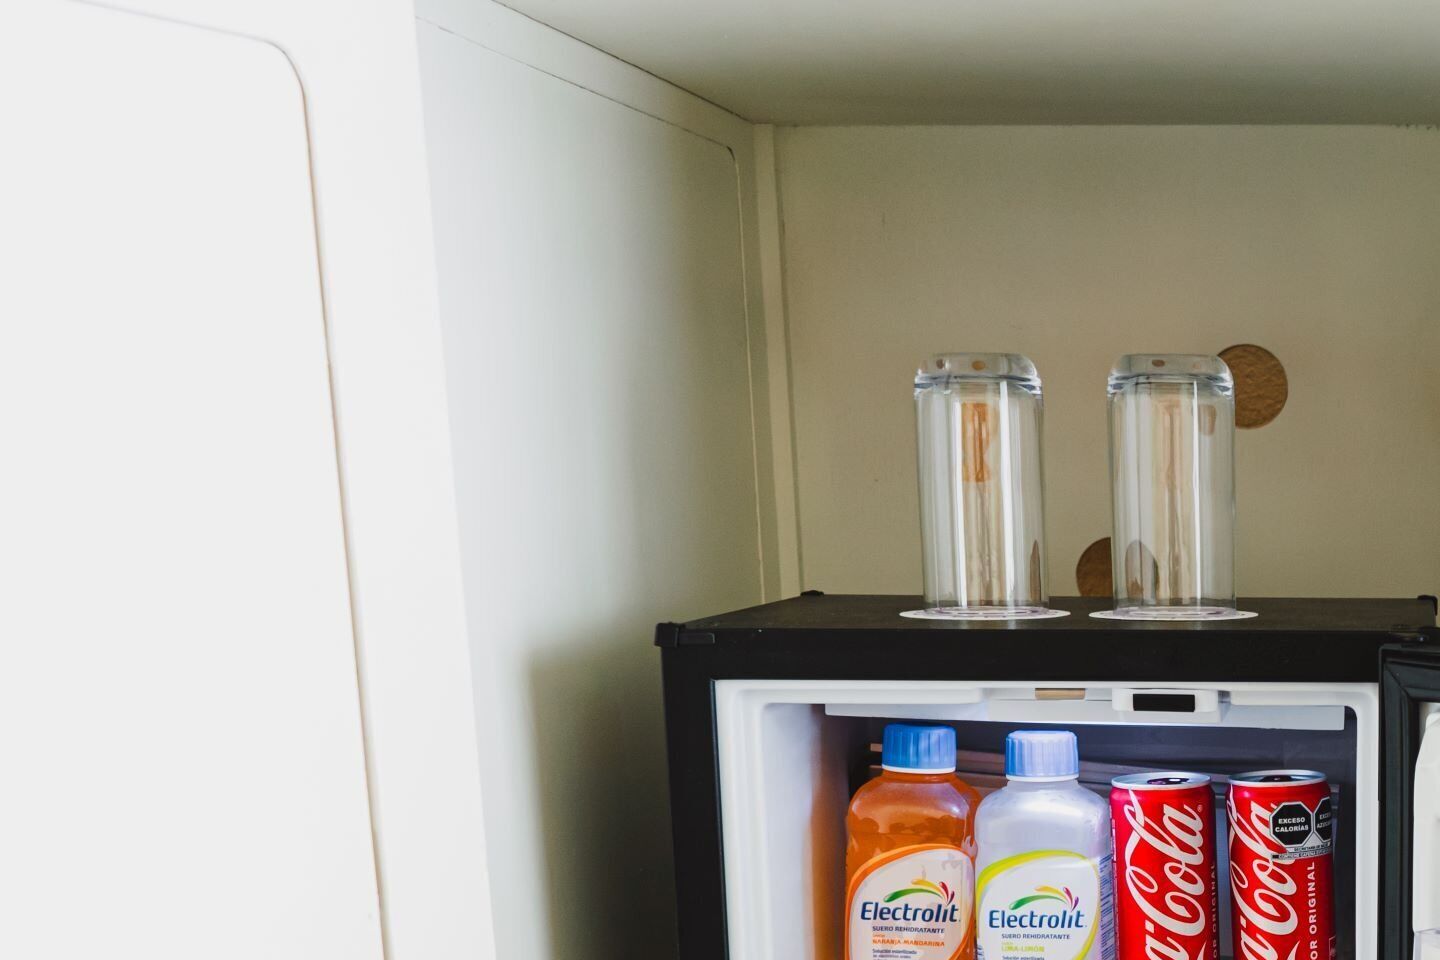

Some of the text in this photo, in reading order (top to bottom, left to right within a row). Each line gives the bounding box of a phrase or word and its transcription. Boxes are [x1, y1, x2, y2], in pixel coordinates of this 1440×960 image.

[1307, 862, 1318, 935] ORIGINAL
[860, 901, 960, 923] Electrolit
[988, 910, 1085, 928] Electrolit
[894, 926, 945, 934] REHIDRATANTE
